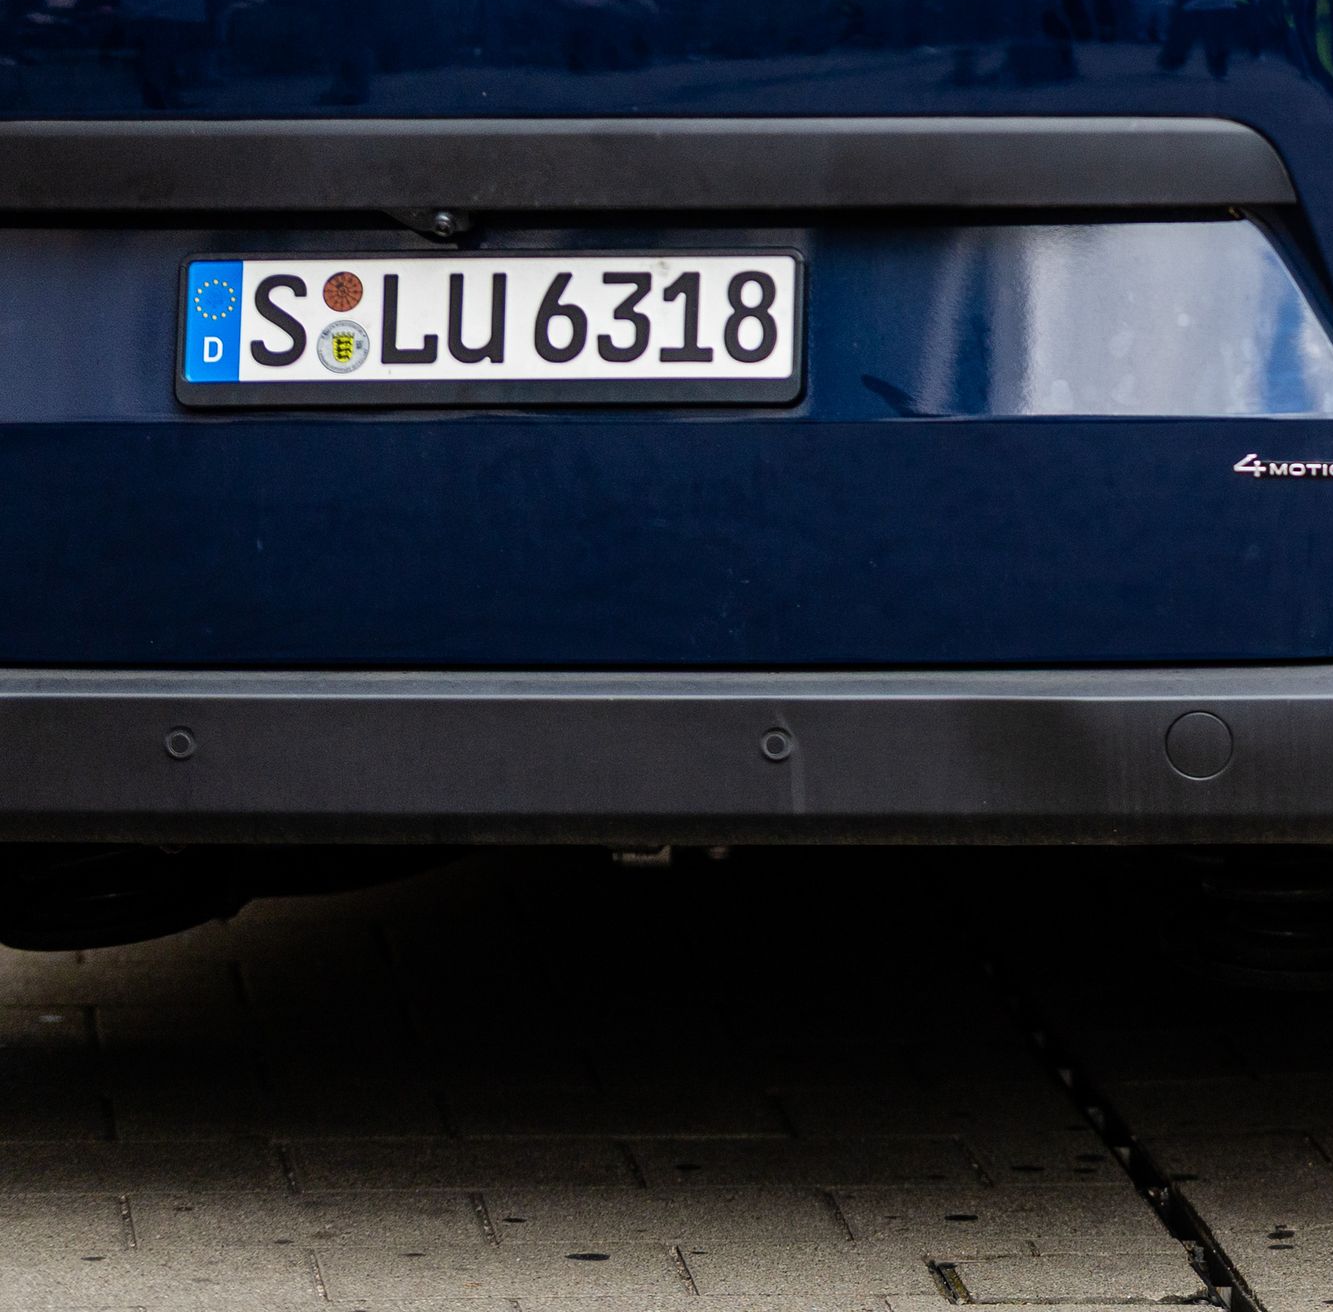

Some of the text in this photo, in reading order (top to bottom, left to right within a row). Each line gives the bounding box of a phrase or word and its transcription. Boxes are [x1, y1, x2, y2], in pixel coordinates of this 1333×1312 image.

[203, 336, 222, 362] D
[251, 274, 307, 367] S
[381, 272, 507, 365] LU
[534, 270, 778, 364] 6318
